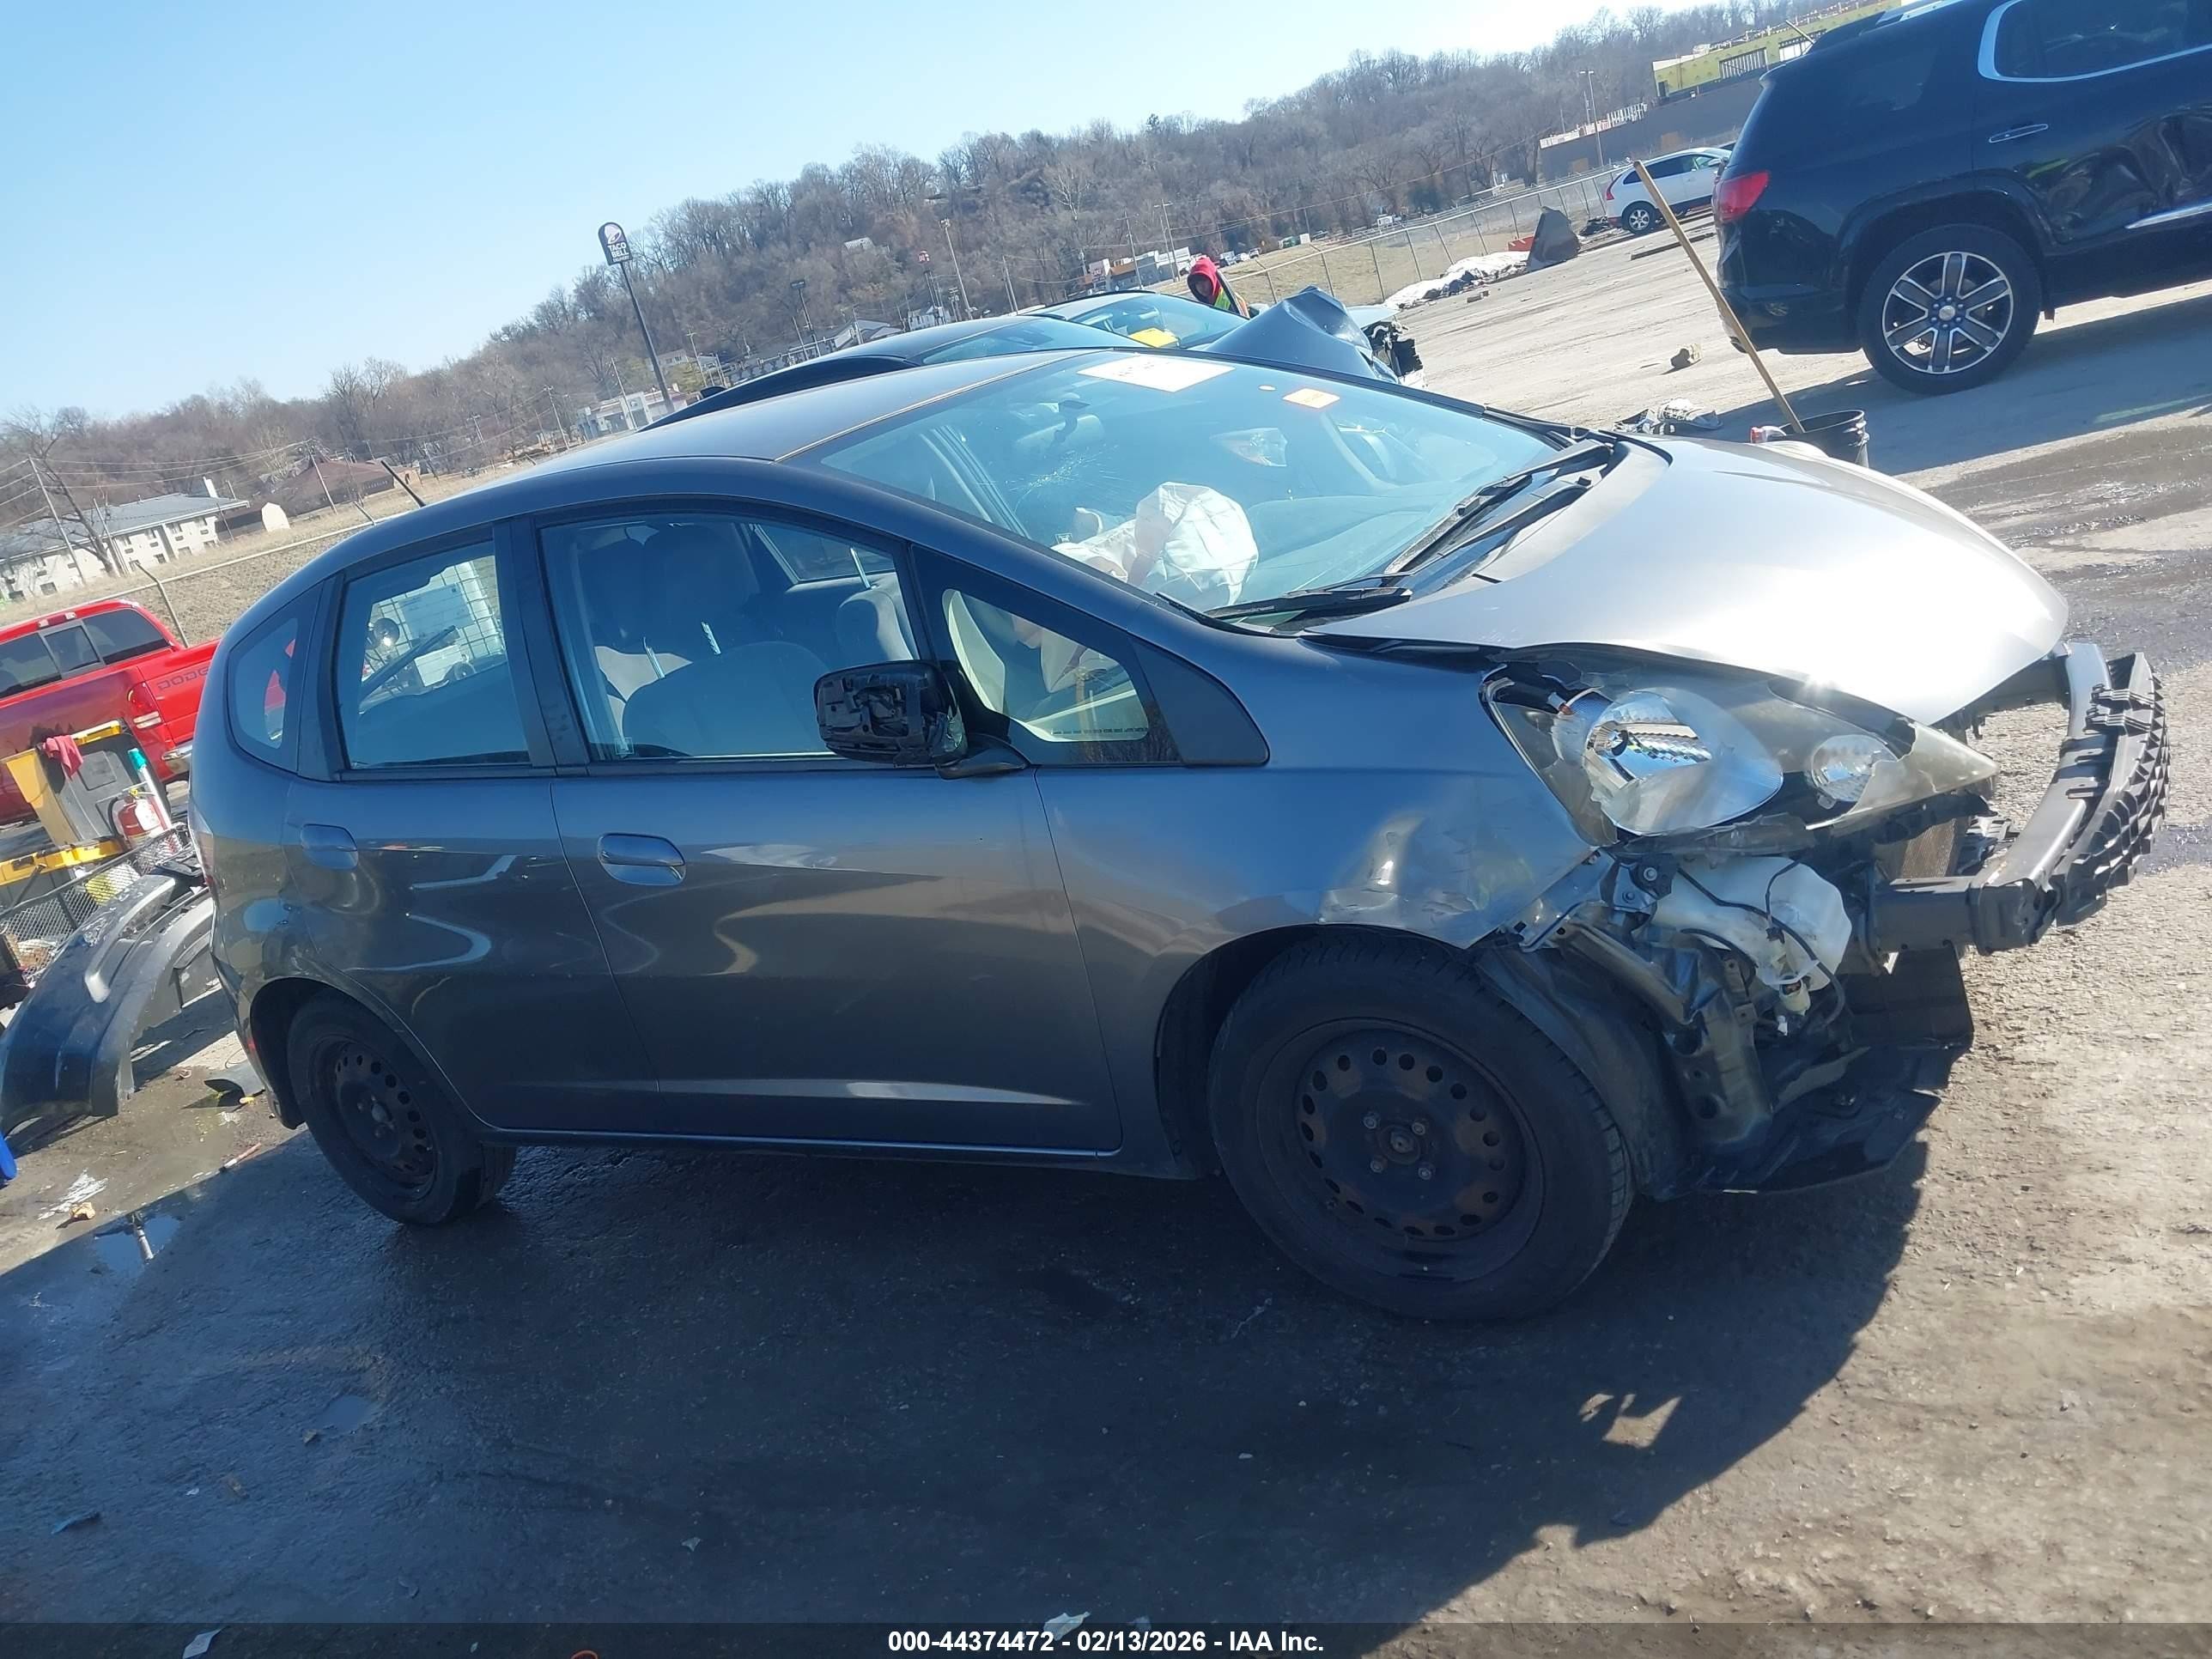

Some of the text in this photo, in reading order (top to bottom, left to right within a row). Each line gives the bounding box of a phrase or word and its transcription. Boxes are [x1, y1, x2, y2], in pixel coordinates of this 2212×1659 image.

[607, 242, 627, 252] TACO
[611, 249, 629, 258] BELL
[156, 665, 209, 690] DODG
